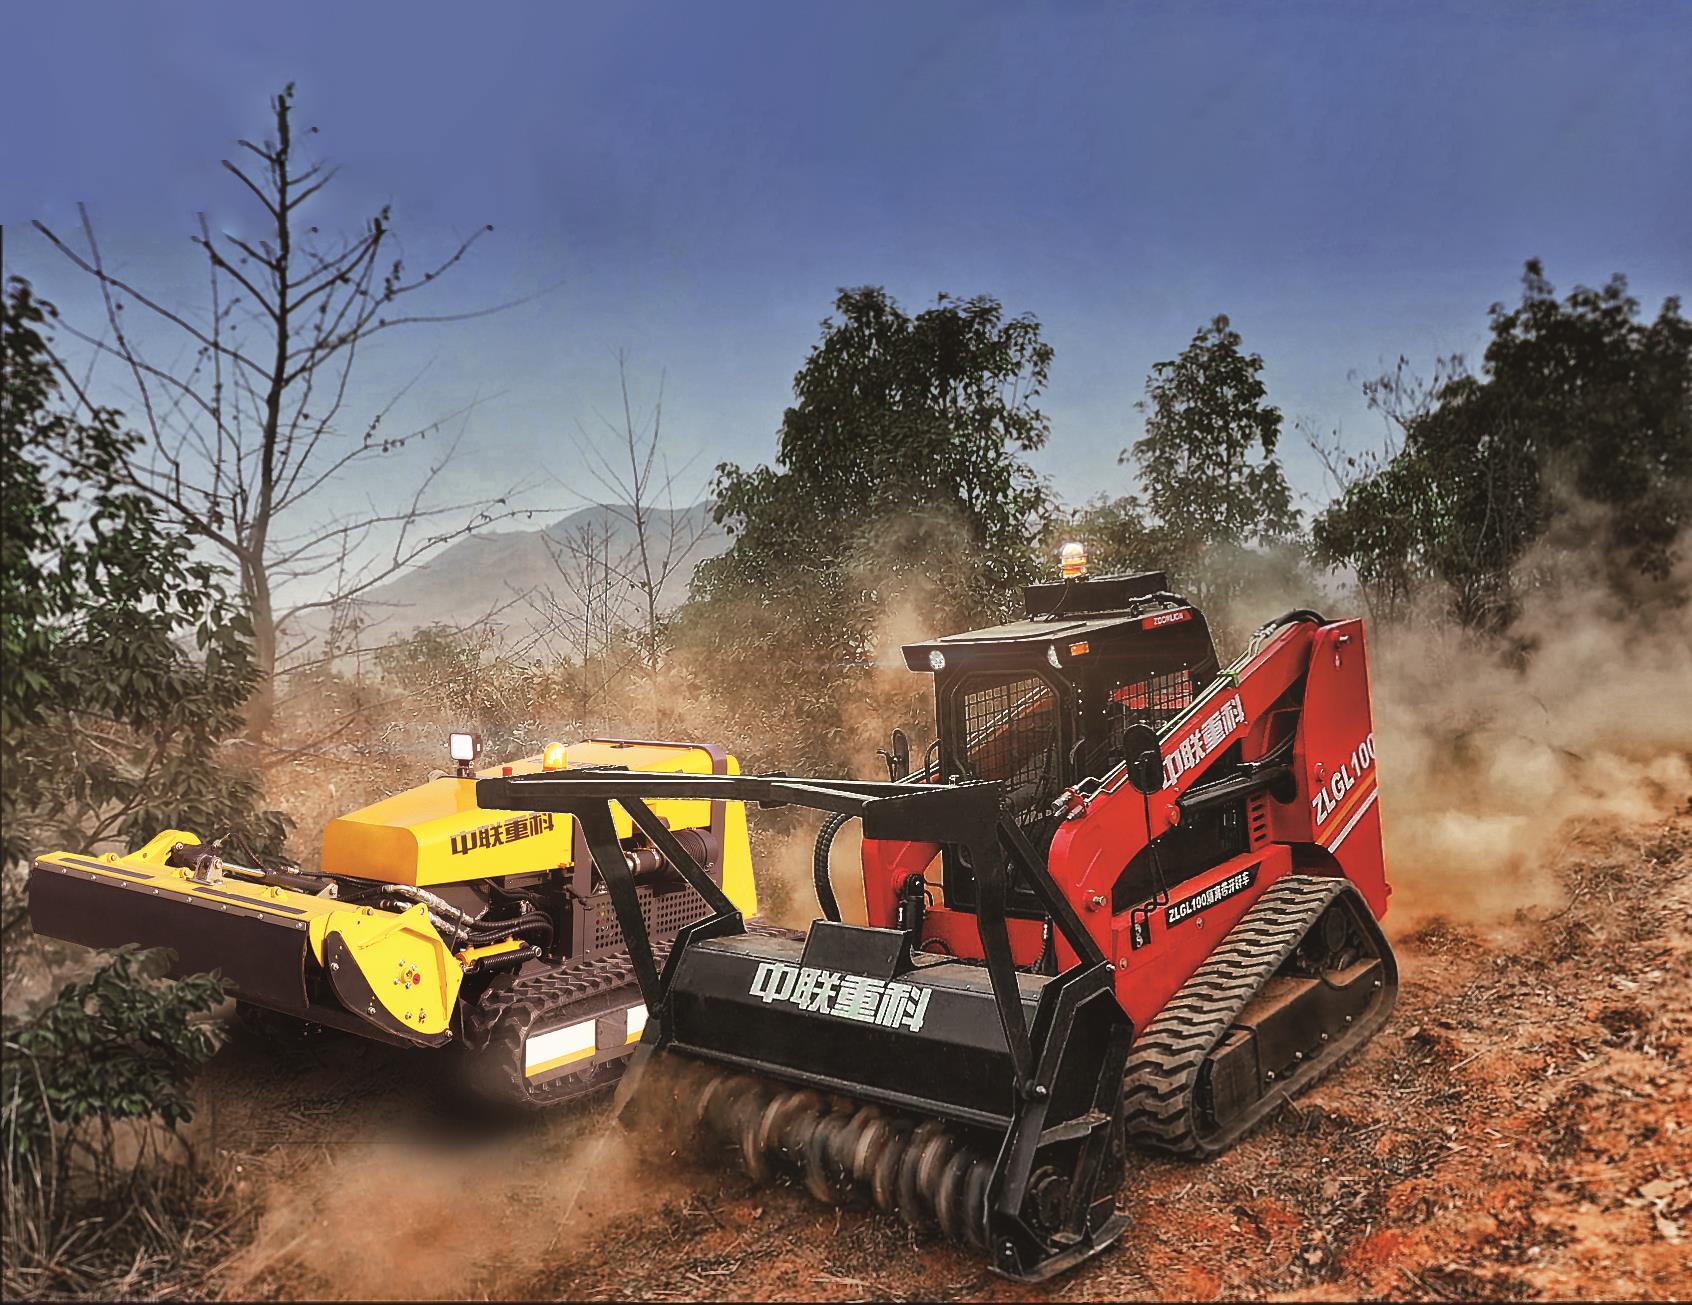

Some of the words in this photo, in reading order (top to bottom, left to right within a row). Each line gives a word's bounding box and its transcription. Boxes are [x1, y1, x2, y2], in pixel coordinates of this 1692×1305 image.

[1162, 693, 1245, 790] 中联重科
[450, 812, 554, 855] 中联重科
[749, 962, 932, 1033] 中联重科
